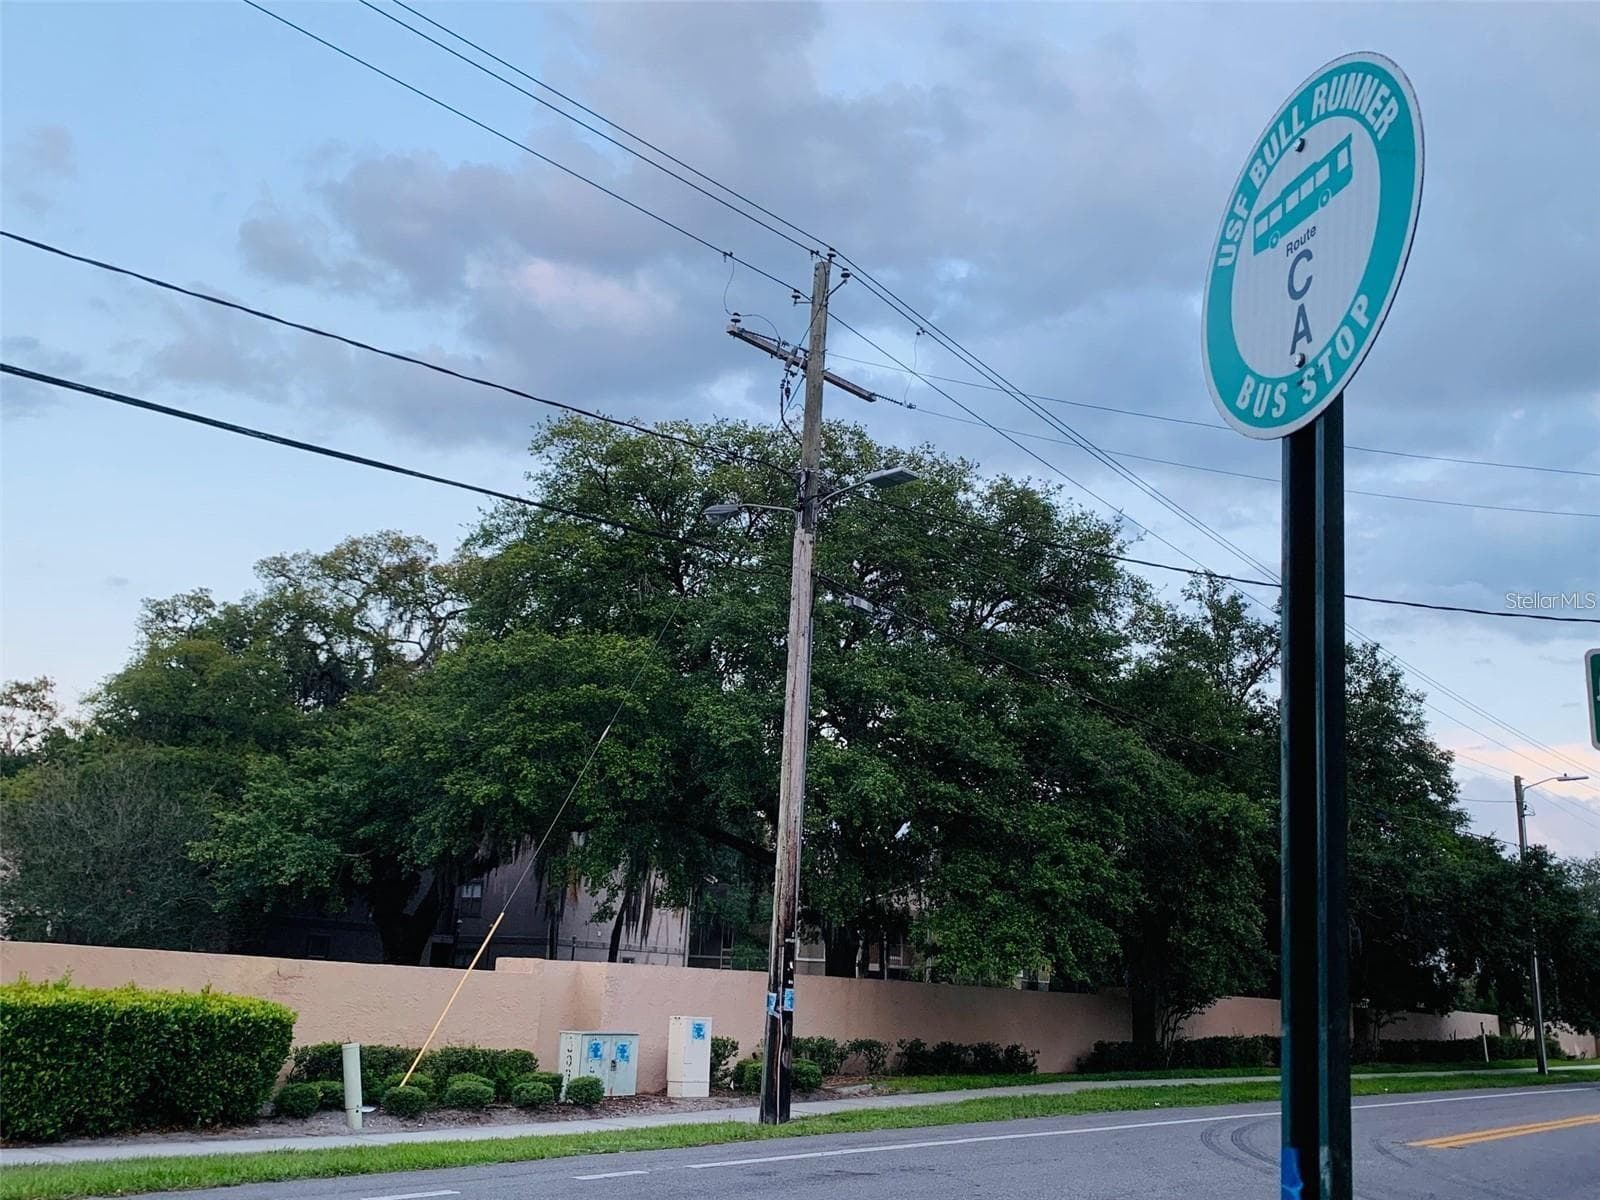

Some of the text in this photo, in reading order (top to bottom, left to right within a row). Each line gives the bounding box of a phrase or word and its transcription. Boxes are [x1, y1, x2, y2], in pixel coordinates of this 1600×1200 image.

[1216, 72, 1399, 267] USF BULL RUNNER
[1286, 224, 1317, 257] Route
[1287, 248, 1313, 301] C
[1289, 302, 1313, 356] A
[1235, 294, 1370, 419] BUS STOP
